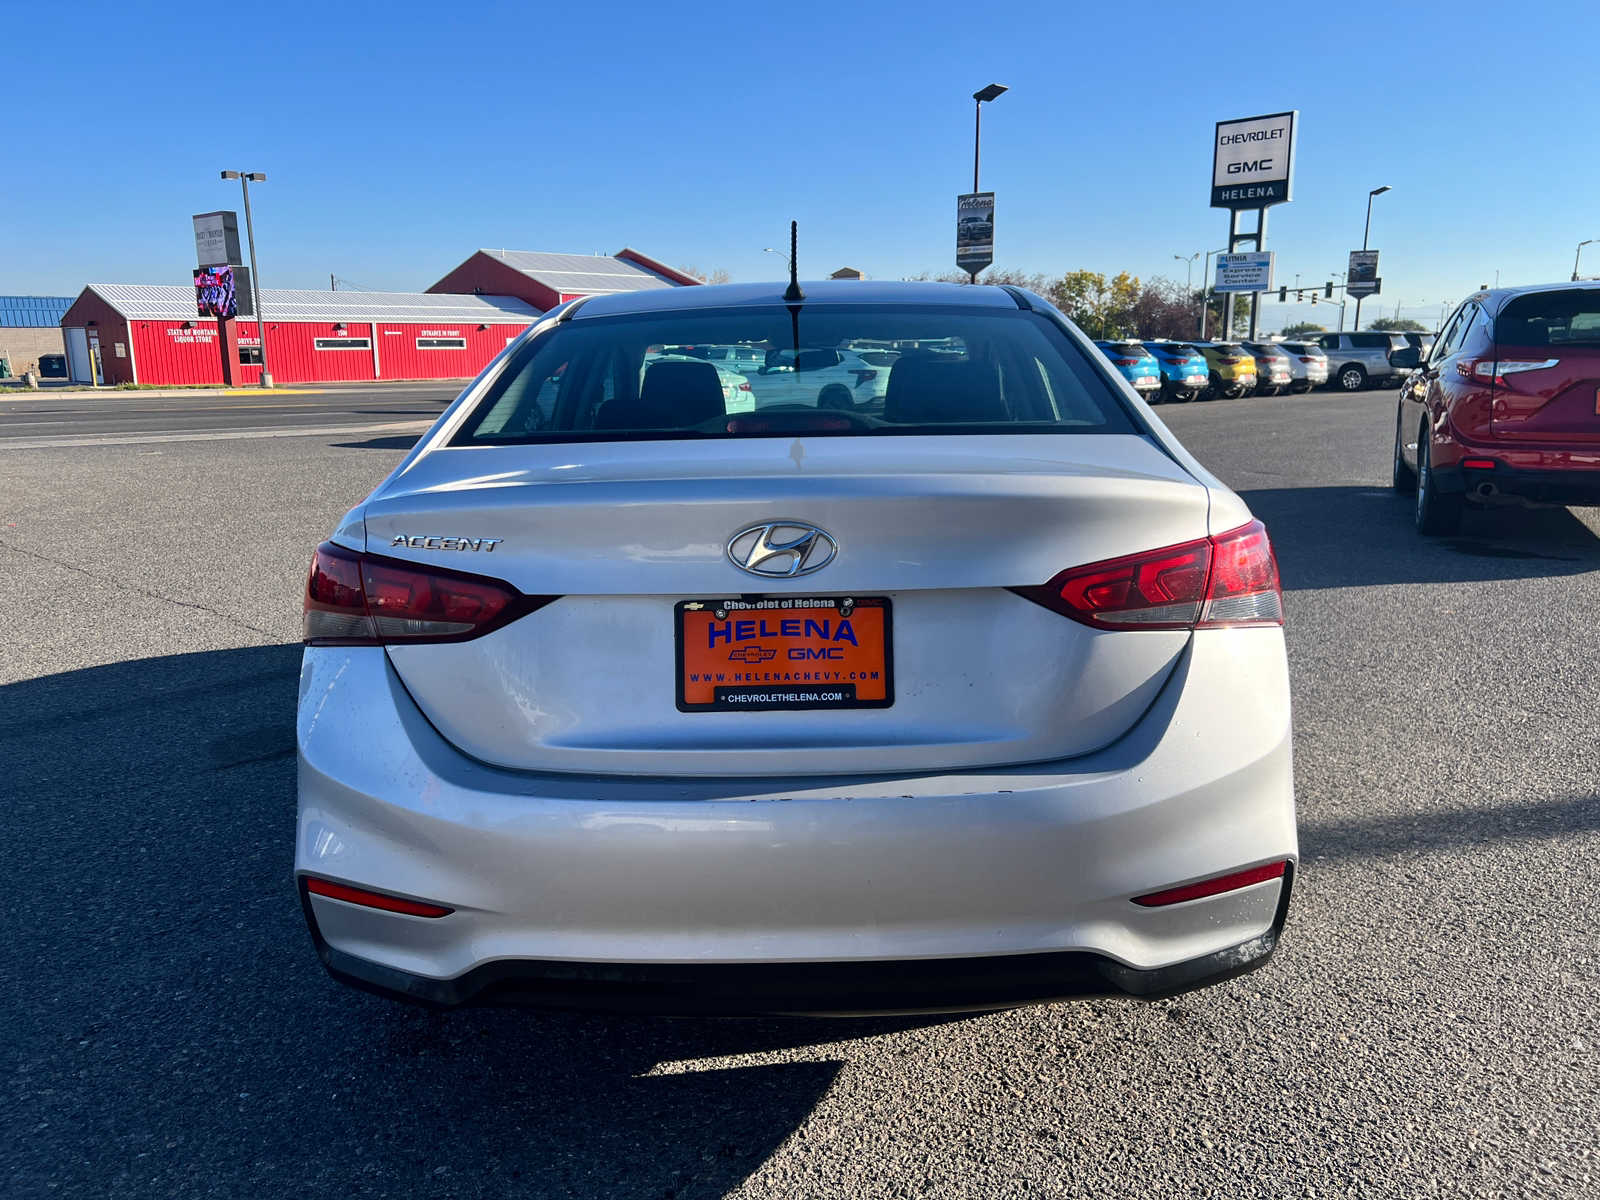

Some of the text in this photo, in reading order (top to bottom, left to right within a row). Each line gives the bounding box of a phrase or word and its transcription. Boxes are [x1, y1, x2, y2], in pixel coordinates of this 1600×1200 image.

[1220, 128, 1285, 146] CHEVROLET
[1227, 159, 1273, 174] GMC
[1221, 186, 1274, 200] HELENA
[167, 328, 183, 336] STATE
[184, 328, 191, 336] OF
[174, 335, 212, 344] LIQUOR STORE
[390, 534, 504, 552] ACCENT
[723, 598, 835, 610] Chevrolet of Helena
[708, 618, 859, 648] HELENA
[787, 647, 844, 660] GMC
[689, 671, 880, 682] WWW.HELENACHEVY.COM
[727, 692, 843, 703] CHEVROLETHELENA.COM
